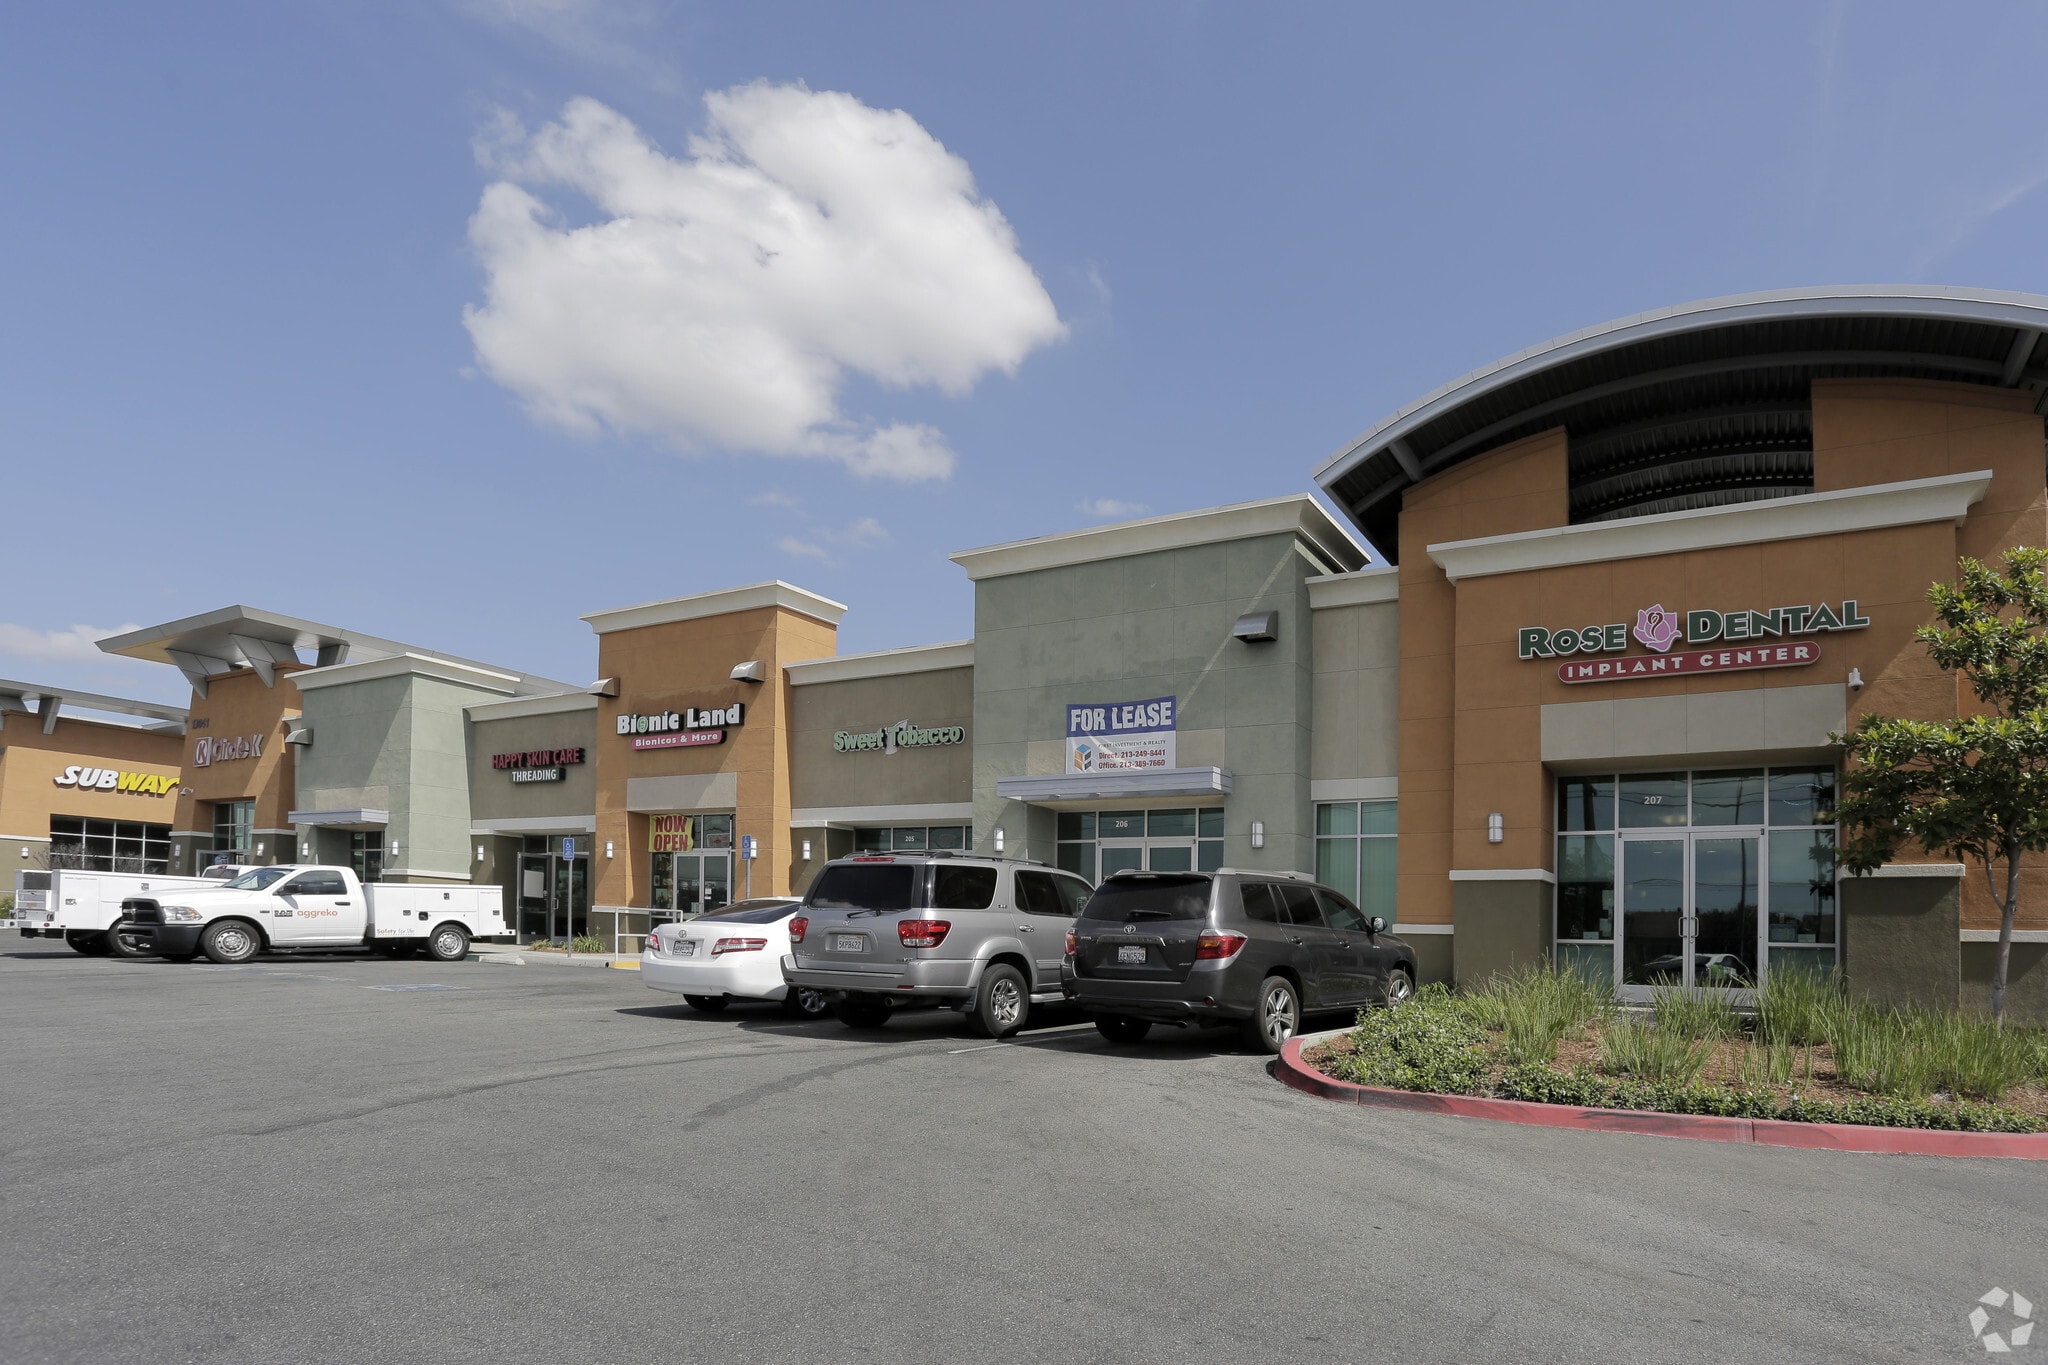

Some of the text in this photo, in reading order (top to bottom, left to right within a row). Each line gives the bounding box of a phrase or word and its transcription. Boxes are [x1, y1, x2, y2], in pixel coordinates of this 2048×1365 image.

[1518, 600, 1870, 660] ROSE DENTAL
[1567, 646, 1811, 678] IMPLANT CENTER
[617, 703, 740, 734] Bionic Land
[1070, 701, 1172, 732] FOR LEASE
[635, 733, 719, 747] Bionicos & More
[833, 724, 963, 752] Sweet Tobacco
[492, 746, 581, 769] HAPPY SKIN CARE
[54, 765, 181, 795] SUBWAY
[511, 769, 557, 782] THREADING
[1644, 795, 1663, 805] 207
[655, 815, 688, 833] NOW
[1115, 820, 1129, 829] 206
[653, 833, 689, 852] OPEN
[905, 835, 915, 843] 205
[297, 908, 339, 919] aggreko
